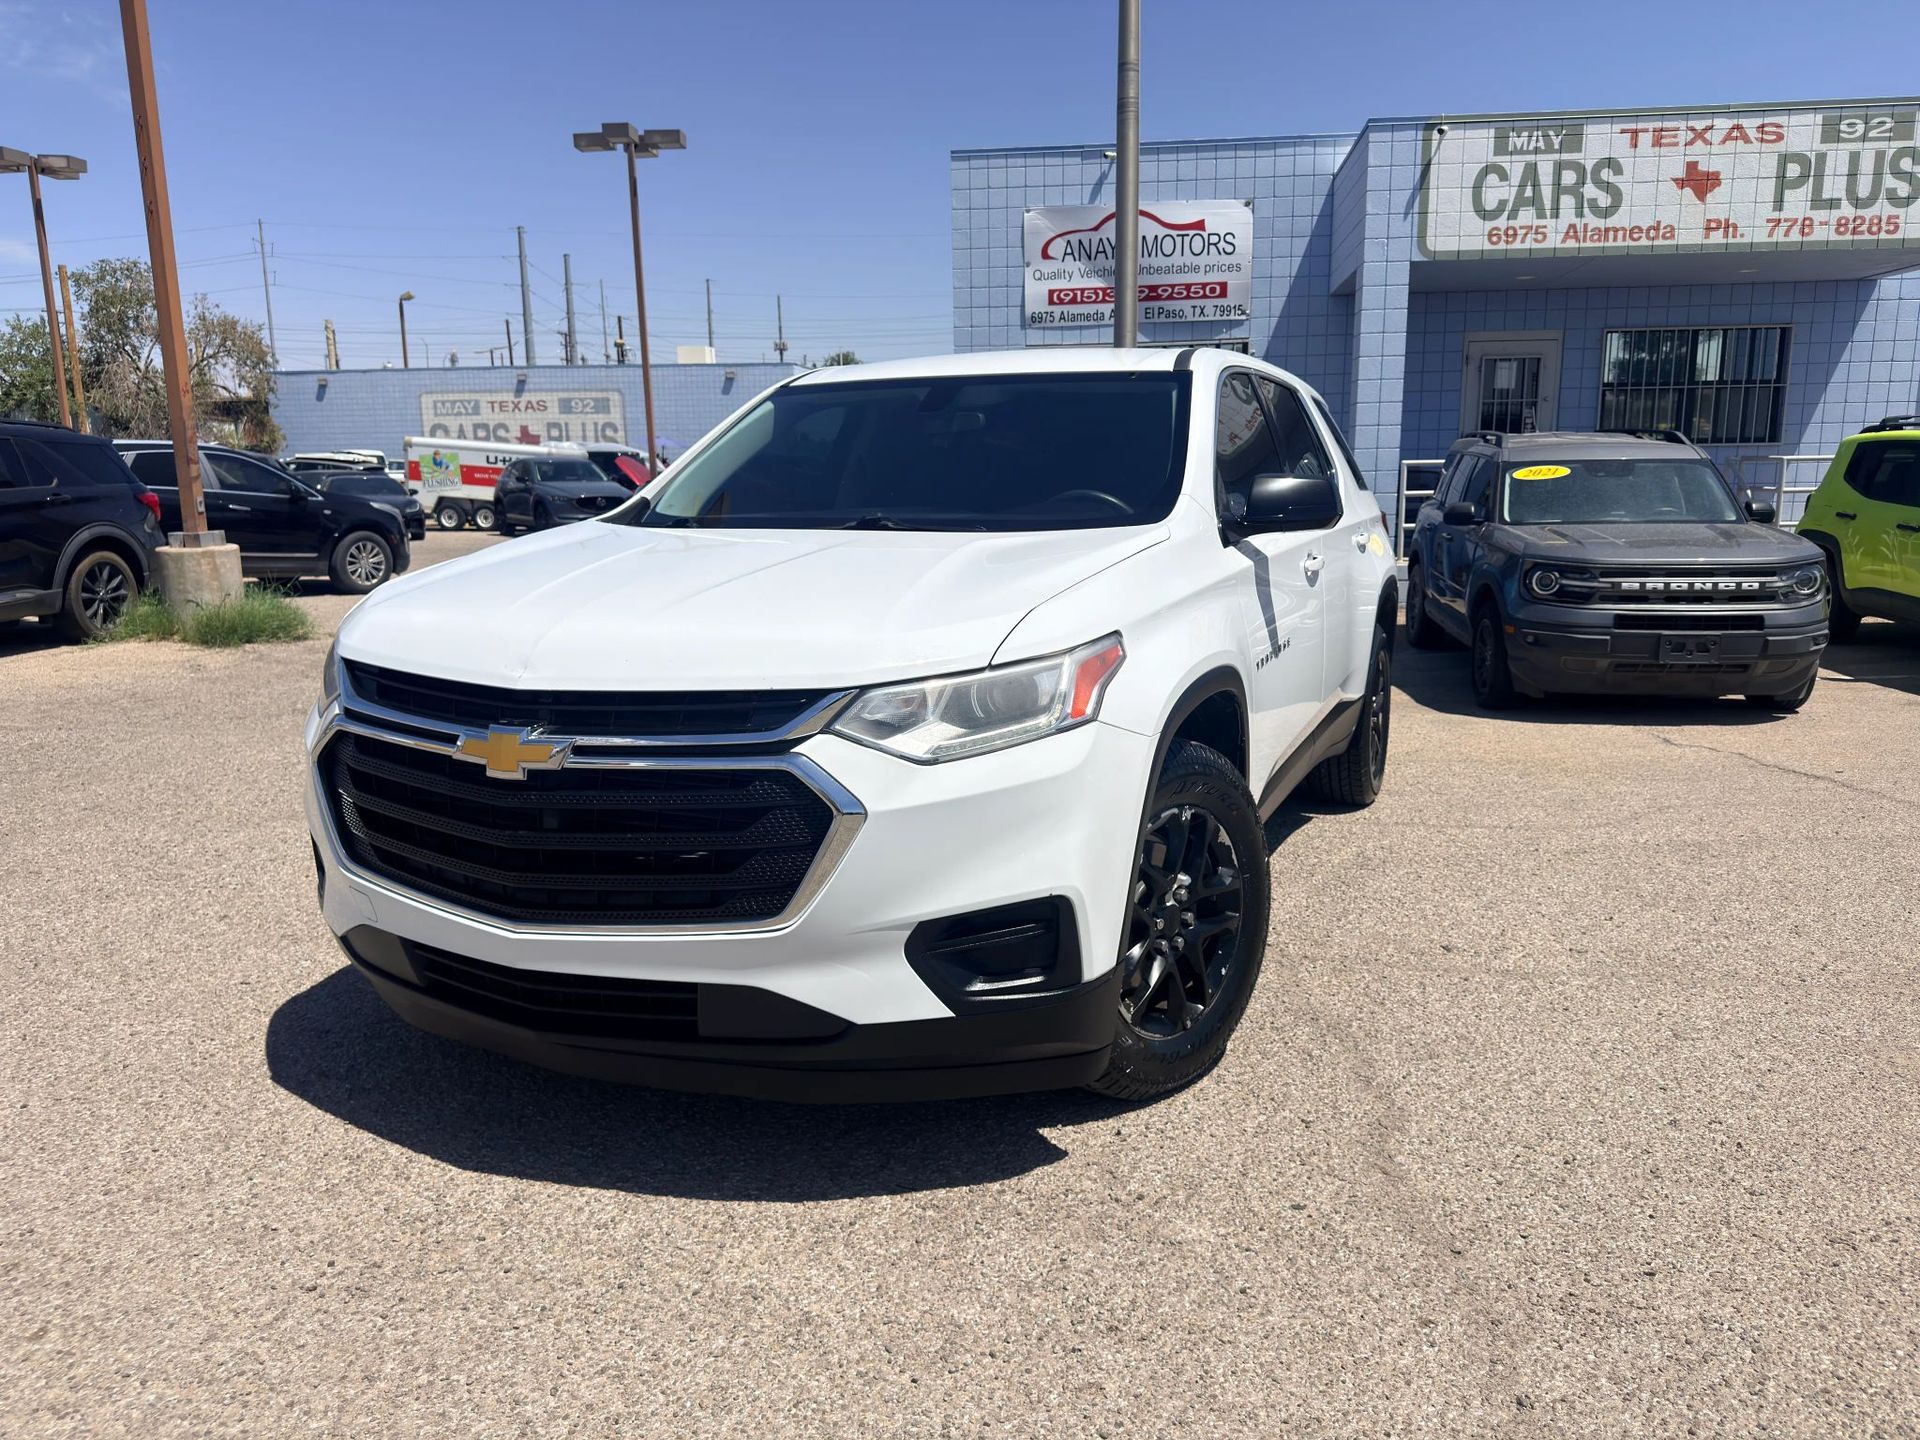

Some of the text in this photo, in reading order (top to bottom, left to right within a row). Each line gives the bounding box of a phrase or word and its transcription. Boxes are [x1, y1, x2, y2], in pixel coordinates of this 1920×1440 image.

[1508, 117, 1895, 151] MAY TEXAS 92
[1472, 147, 1920, 221] CARS PLUS
[1487, 224, 1548, 245] 6975
[1560, 220, 1676, 245] Alameda
[1704, 218, 1745, 239] Ph.
[1061, 232, 1236, 263] ANAY MOTORS
[1033, 267, 1073, 282] Quality
[1204, 261, 1242, 276] prices
[1030, 304, 1243, 324] 6975 Alameda A El Paso, TX. 79915
[436, 399, 594, 415] MAY TEXAS 92
[1523, 467, 1559, 477] 2021
[1621, 582, 1759, 590] BRONCO
